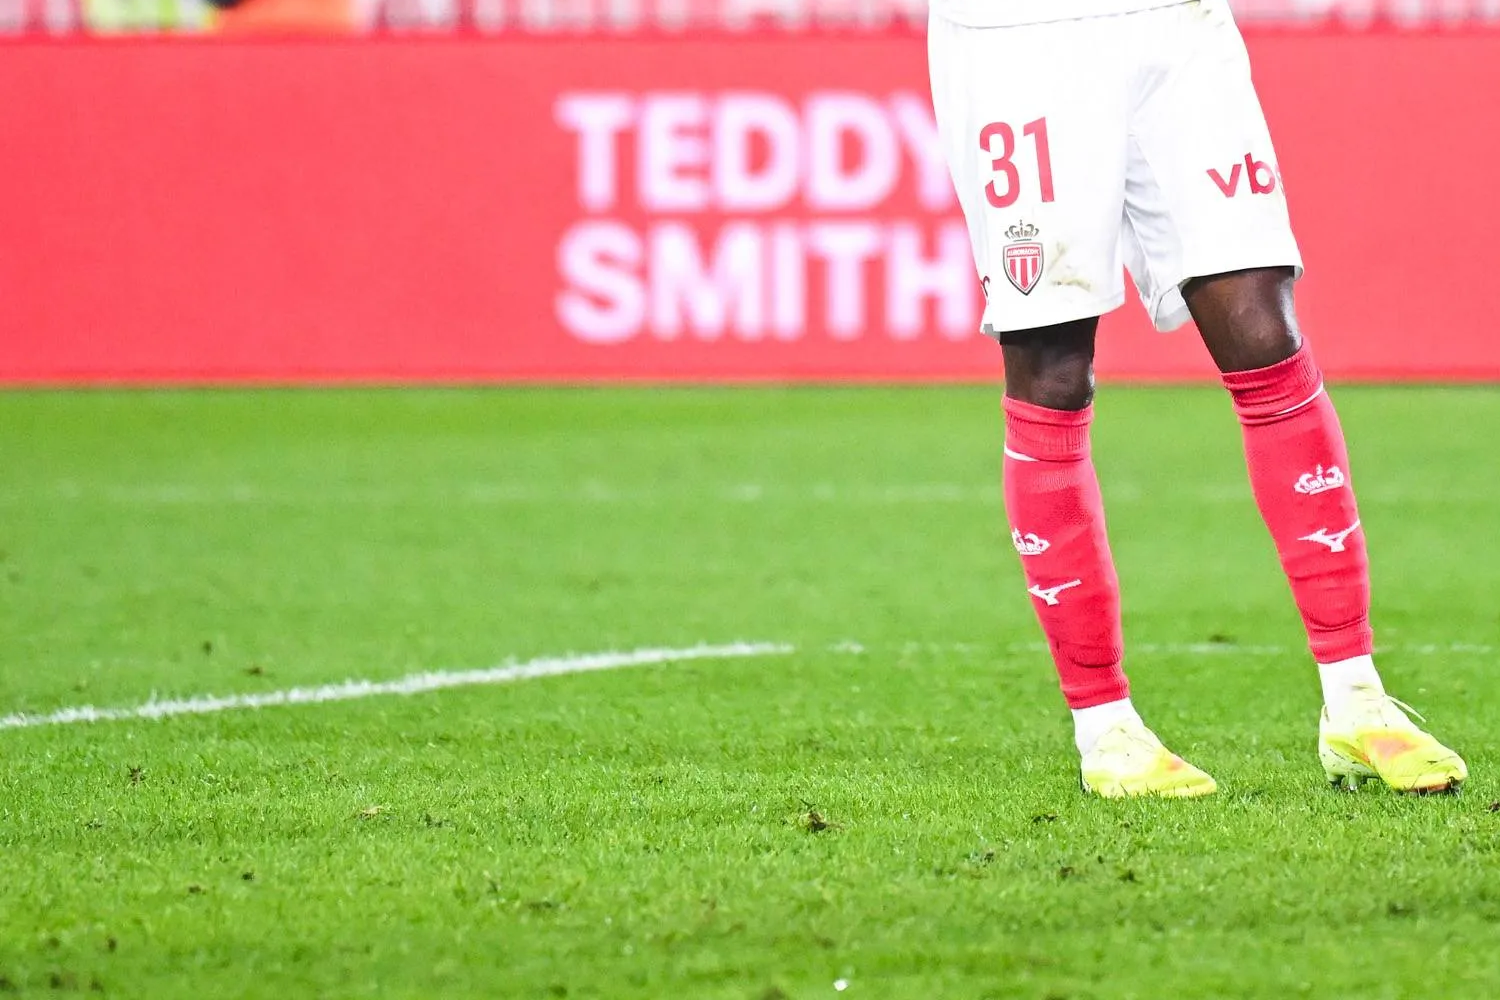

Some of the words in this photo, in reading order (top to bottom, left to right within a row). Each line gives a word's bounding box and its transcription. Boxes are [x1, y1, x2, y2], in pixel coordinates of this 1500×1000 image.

[553, 90, 951, 213] TEDDY
[979, 116, 1055, 209] 31
[1206, 152, 1284, 198] vb
[554, 219, 978, 345] SMITH
